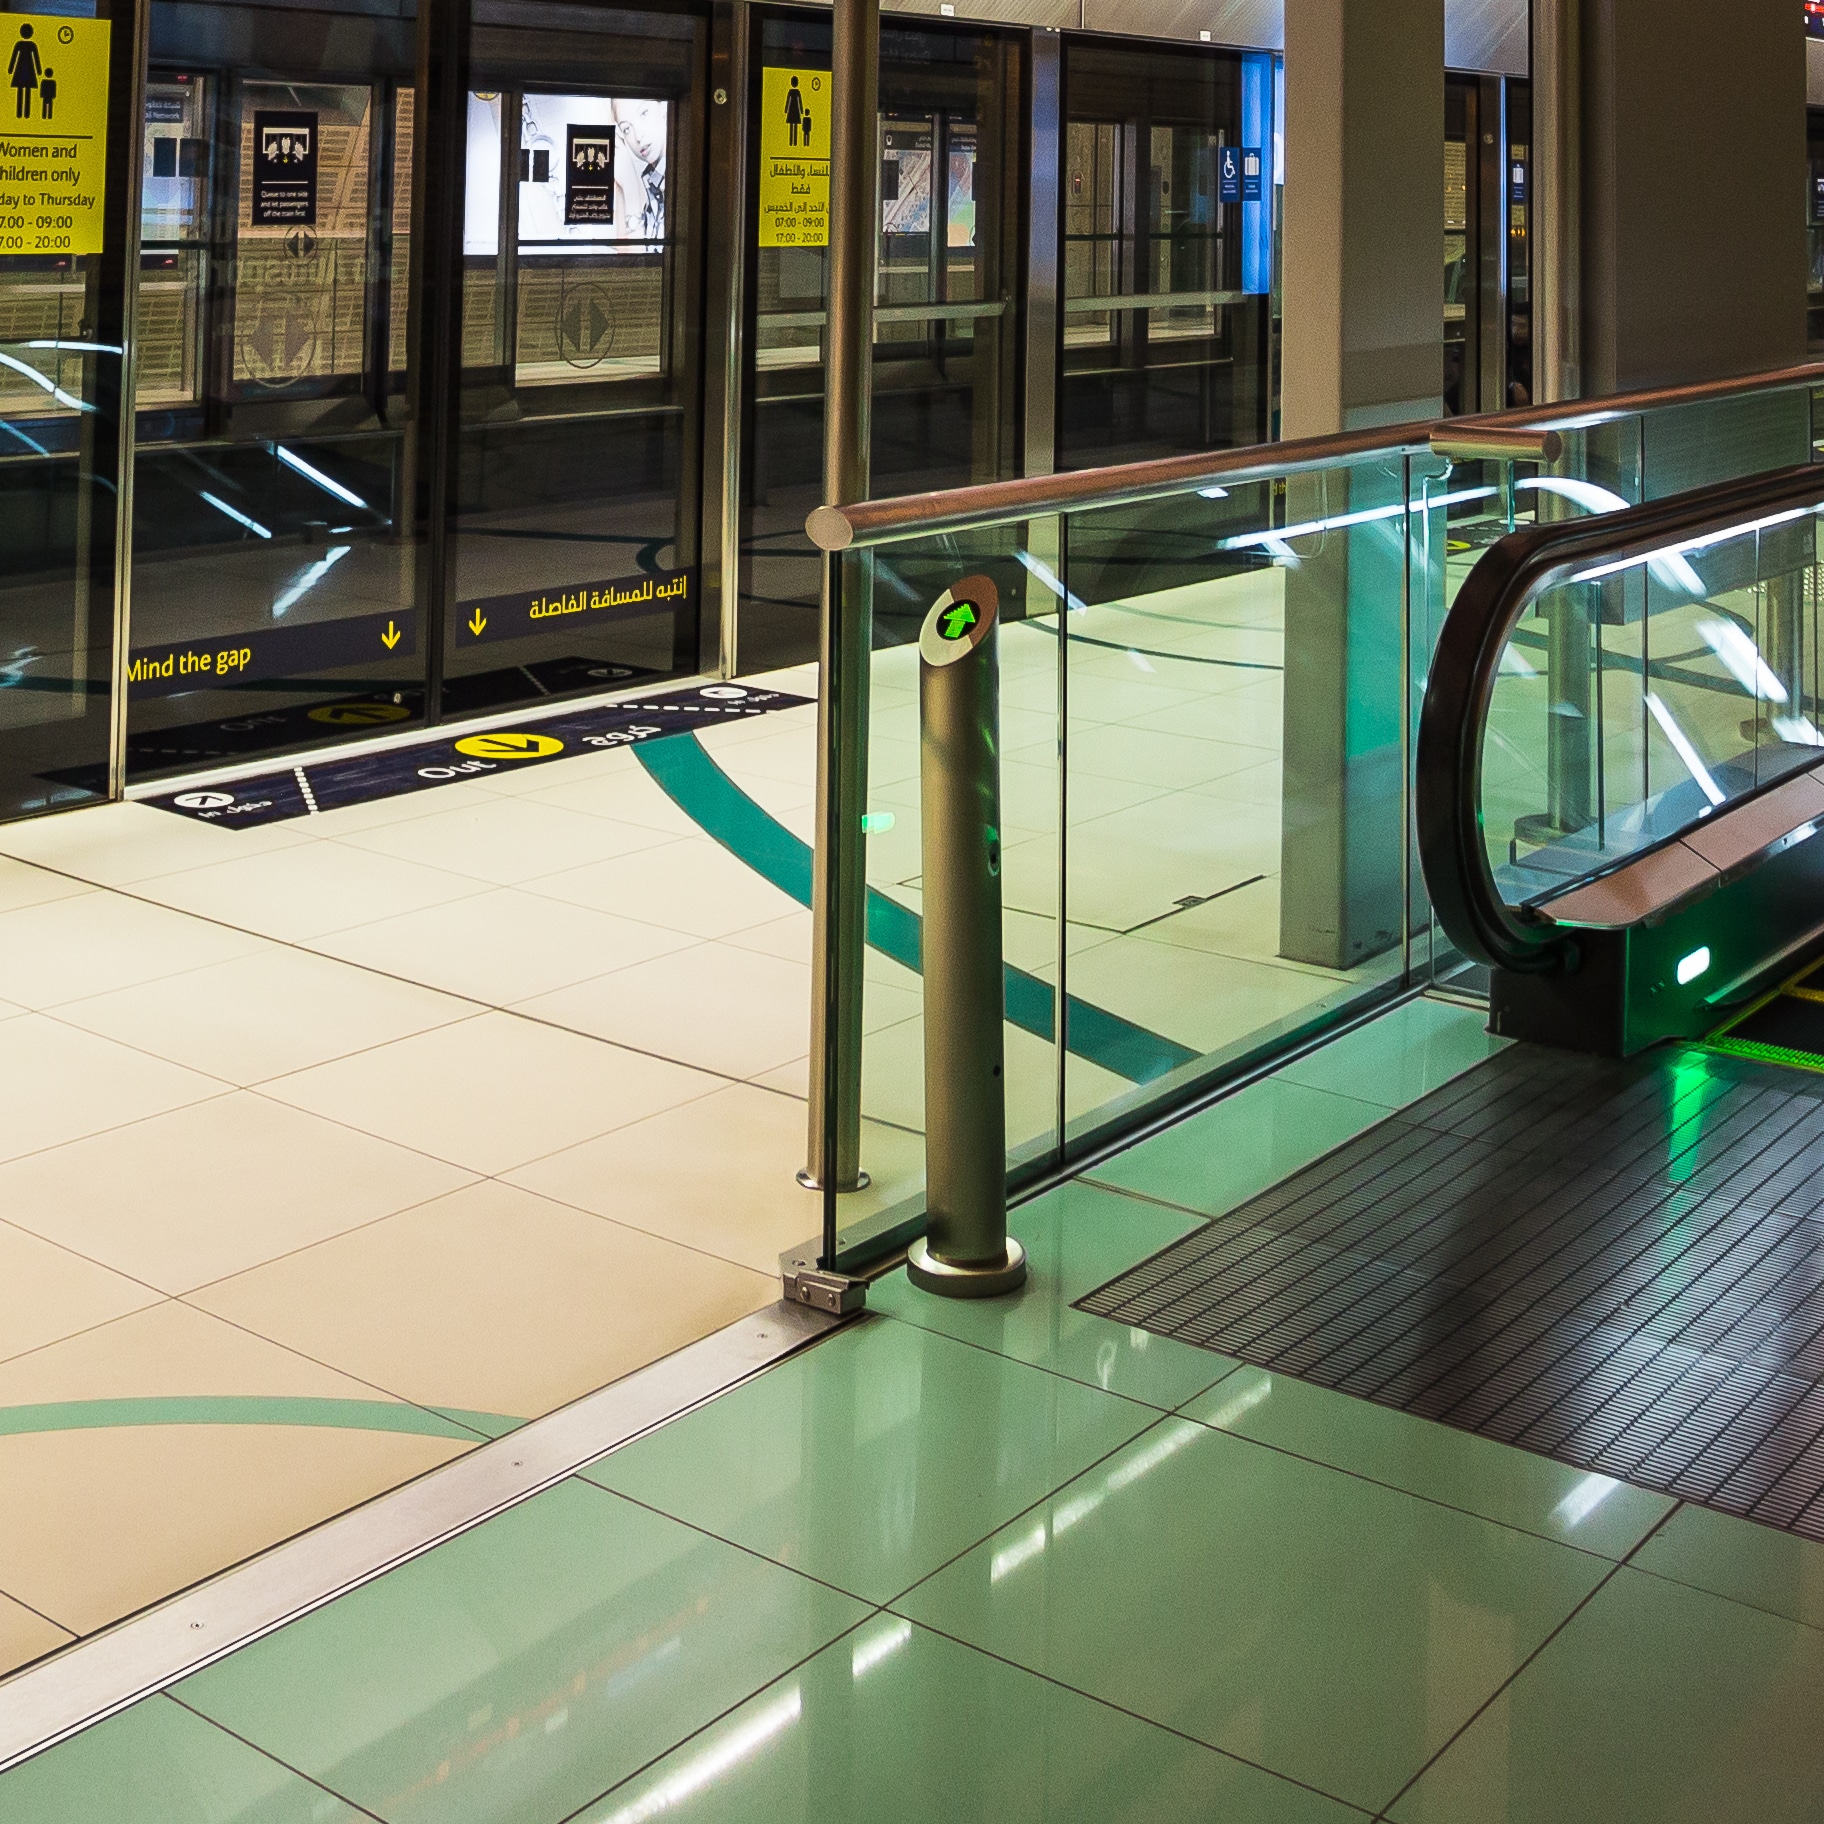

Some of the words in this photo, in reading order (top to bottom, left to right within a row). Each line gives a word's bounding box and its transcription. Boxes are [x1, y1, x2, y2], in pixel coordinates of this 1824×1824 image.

[51, 143, 78, 158] and
[50, 166, 81, 186] only
[790, 182, 811, 195] فقط
[23, 194, 36, 206] to
[38, 192, 96, 210] Thursday
[35, 215, 73, 229] 09:00
[34, 235, 71, 249] 20:00
[589, 579, 653, 609] للمسافة
[529, 590, 587, 619] الفاصلة
[127, 653, 174, 682] Mind
[179, 650, 212, 674] the
[216, 647, 252, 675] gap
[417, 759, 498, 779] Out
